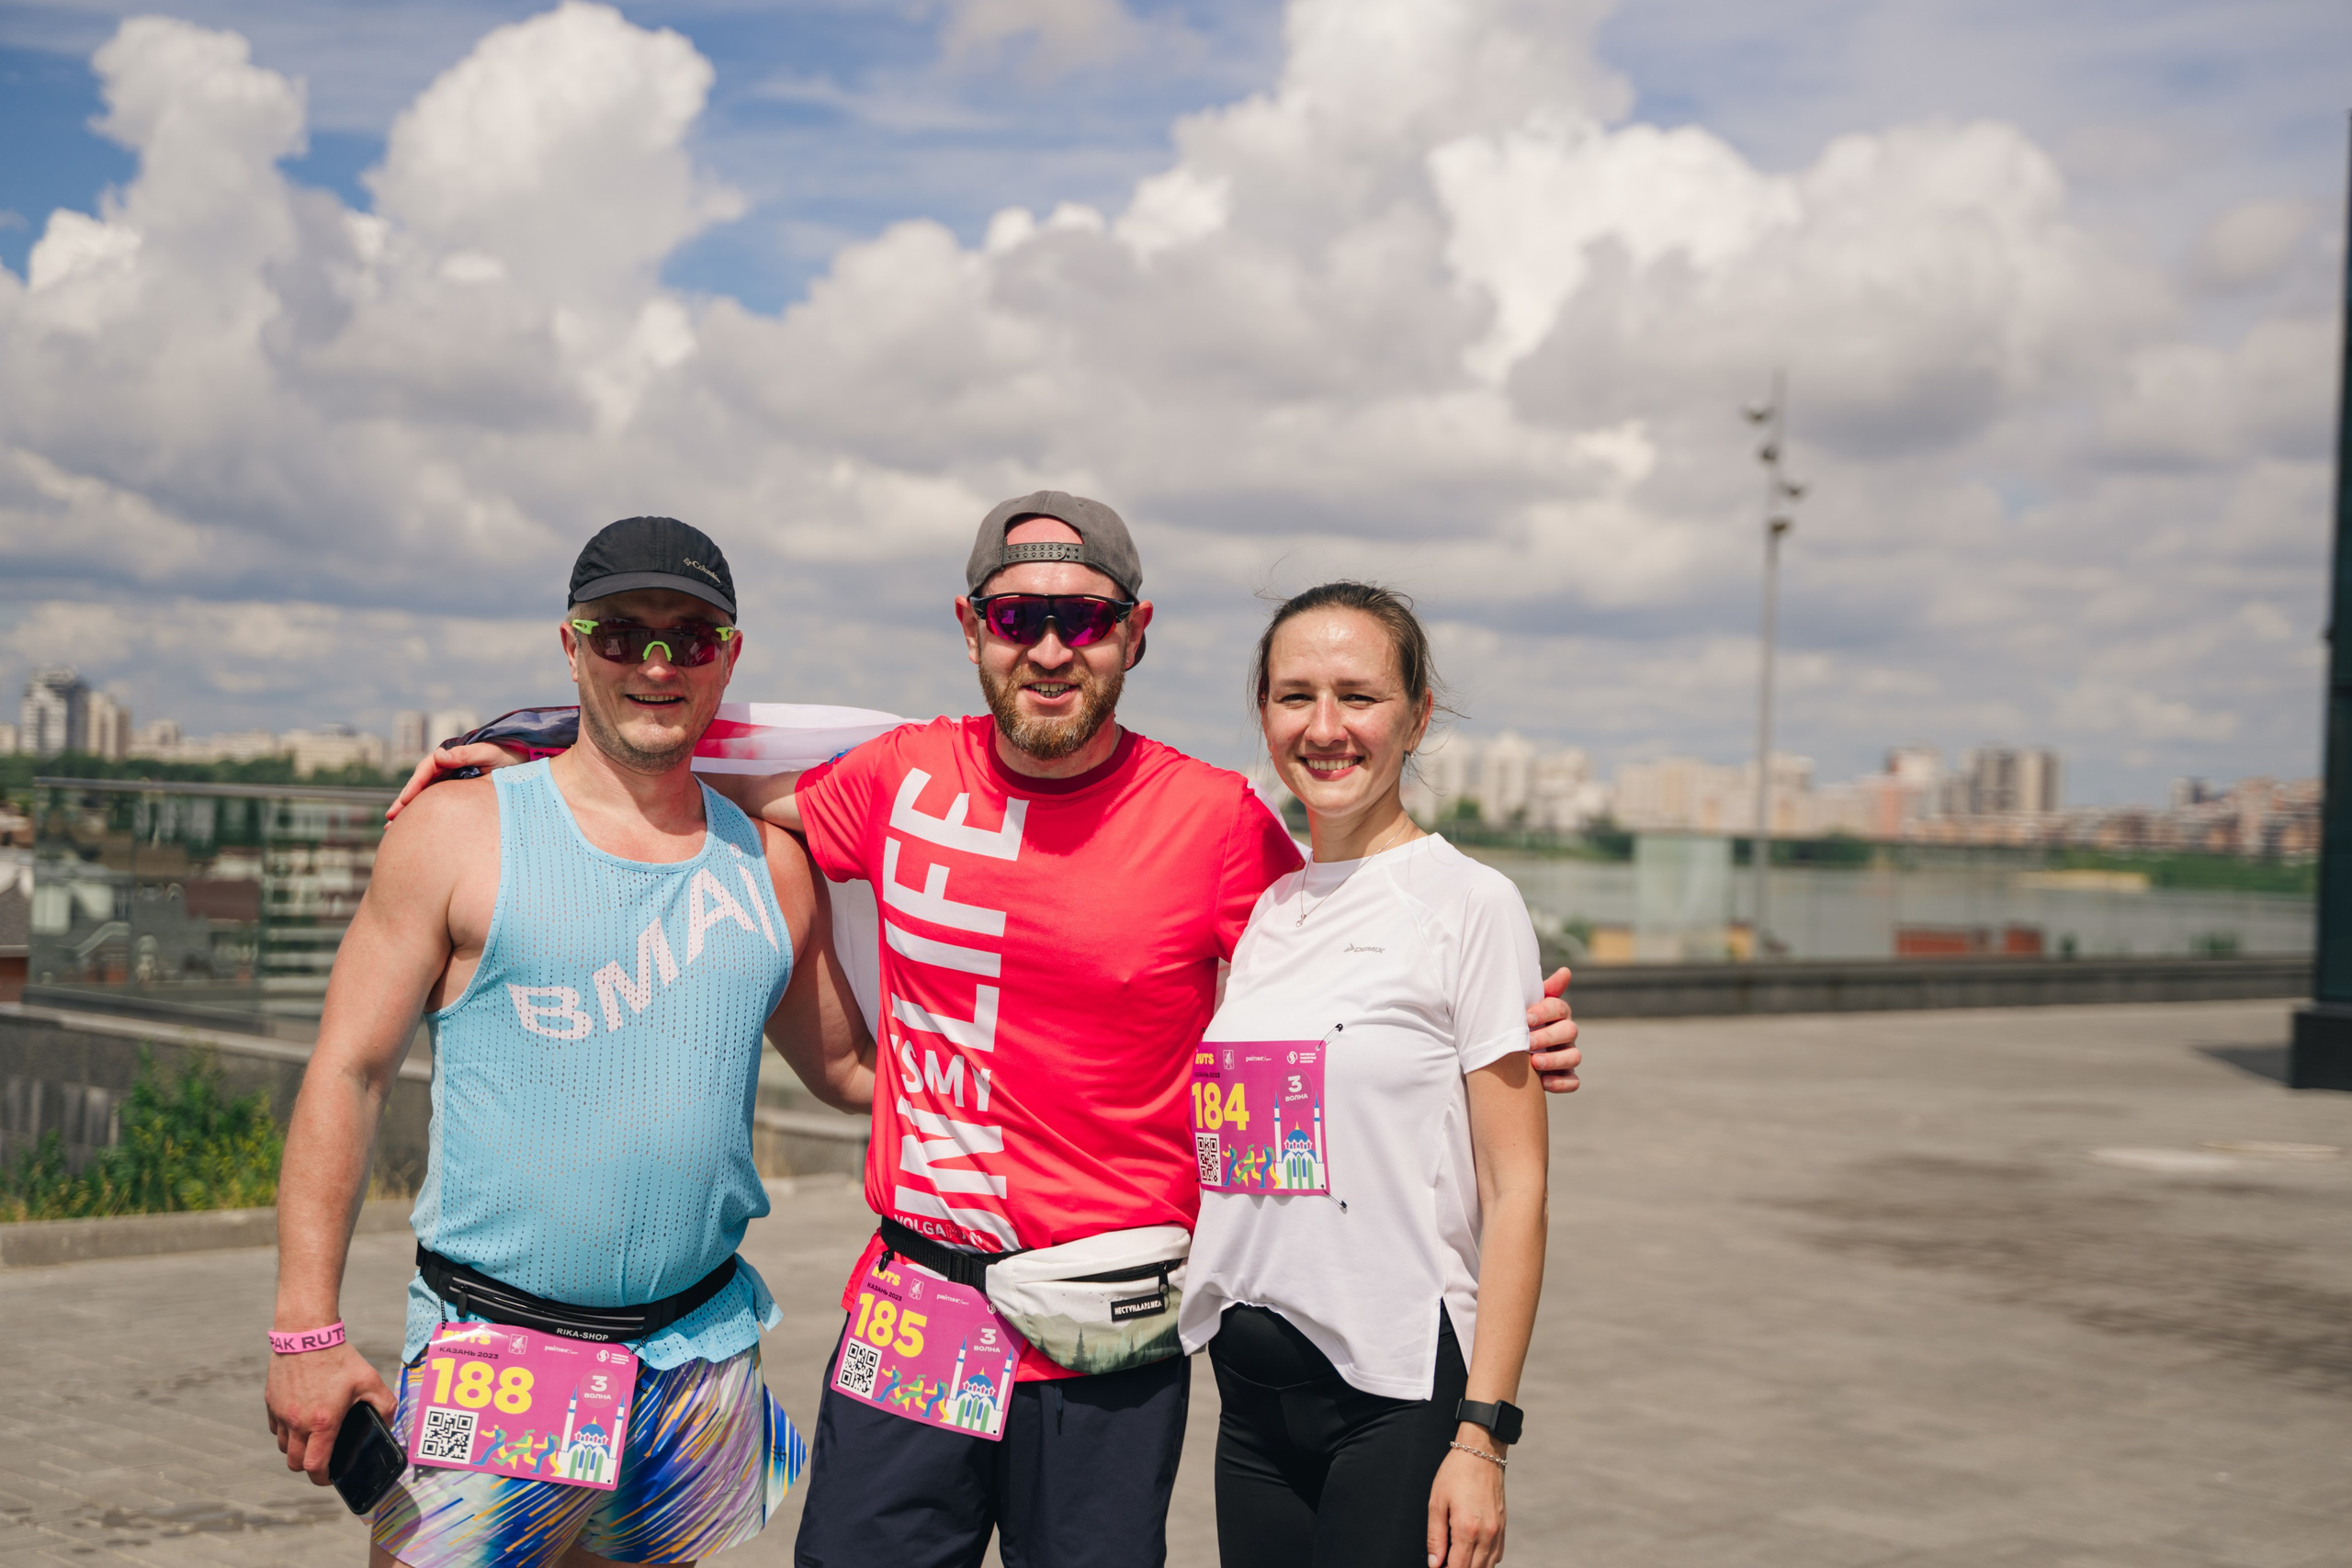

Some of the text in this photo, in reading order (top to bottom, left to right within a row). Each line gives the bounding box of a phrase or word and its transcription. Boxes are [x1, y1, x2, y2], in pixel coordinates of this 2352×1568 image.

[883, 767, 1030, 1053] LIFE
[924, 1050, 991, 1111] MY
[1287, 1075, 1303, 1093] 3
[1192, 1081, 1250, 1131] 184
[1284, 1093, 1308, 1102] ВОЛНА
[866, 1281, 903, 1302] КАЗАНЬ 2023
[556, 1327, 609, 1341] RIKA-SHOP
[854, 1292, 928, 1359] 185
[979, 1327, 997, 1345] 3
[439, 1346, 499, 1359] КАЗАНЬ 2023
[973, 1345, 1001, 1353] ВОЛНА
[431, 1357, 535, 1415] 188
[590, 1374, 608, 1393] 3
[583, 1393, 612, 1401] ВОЛНА
